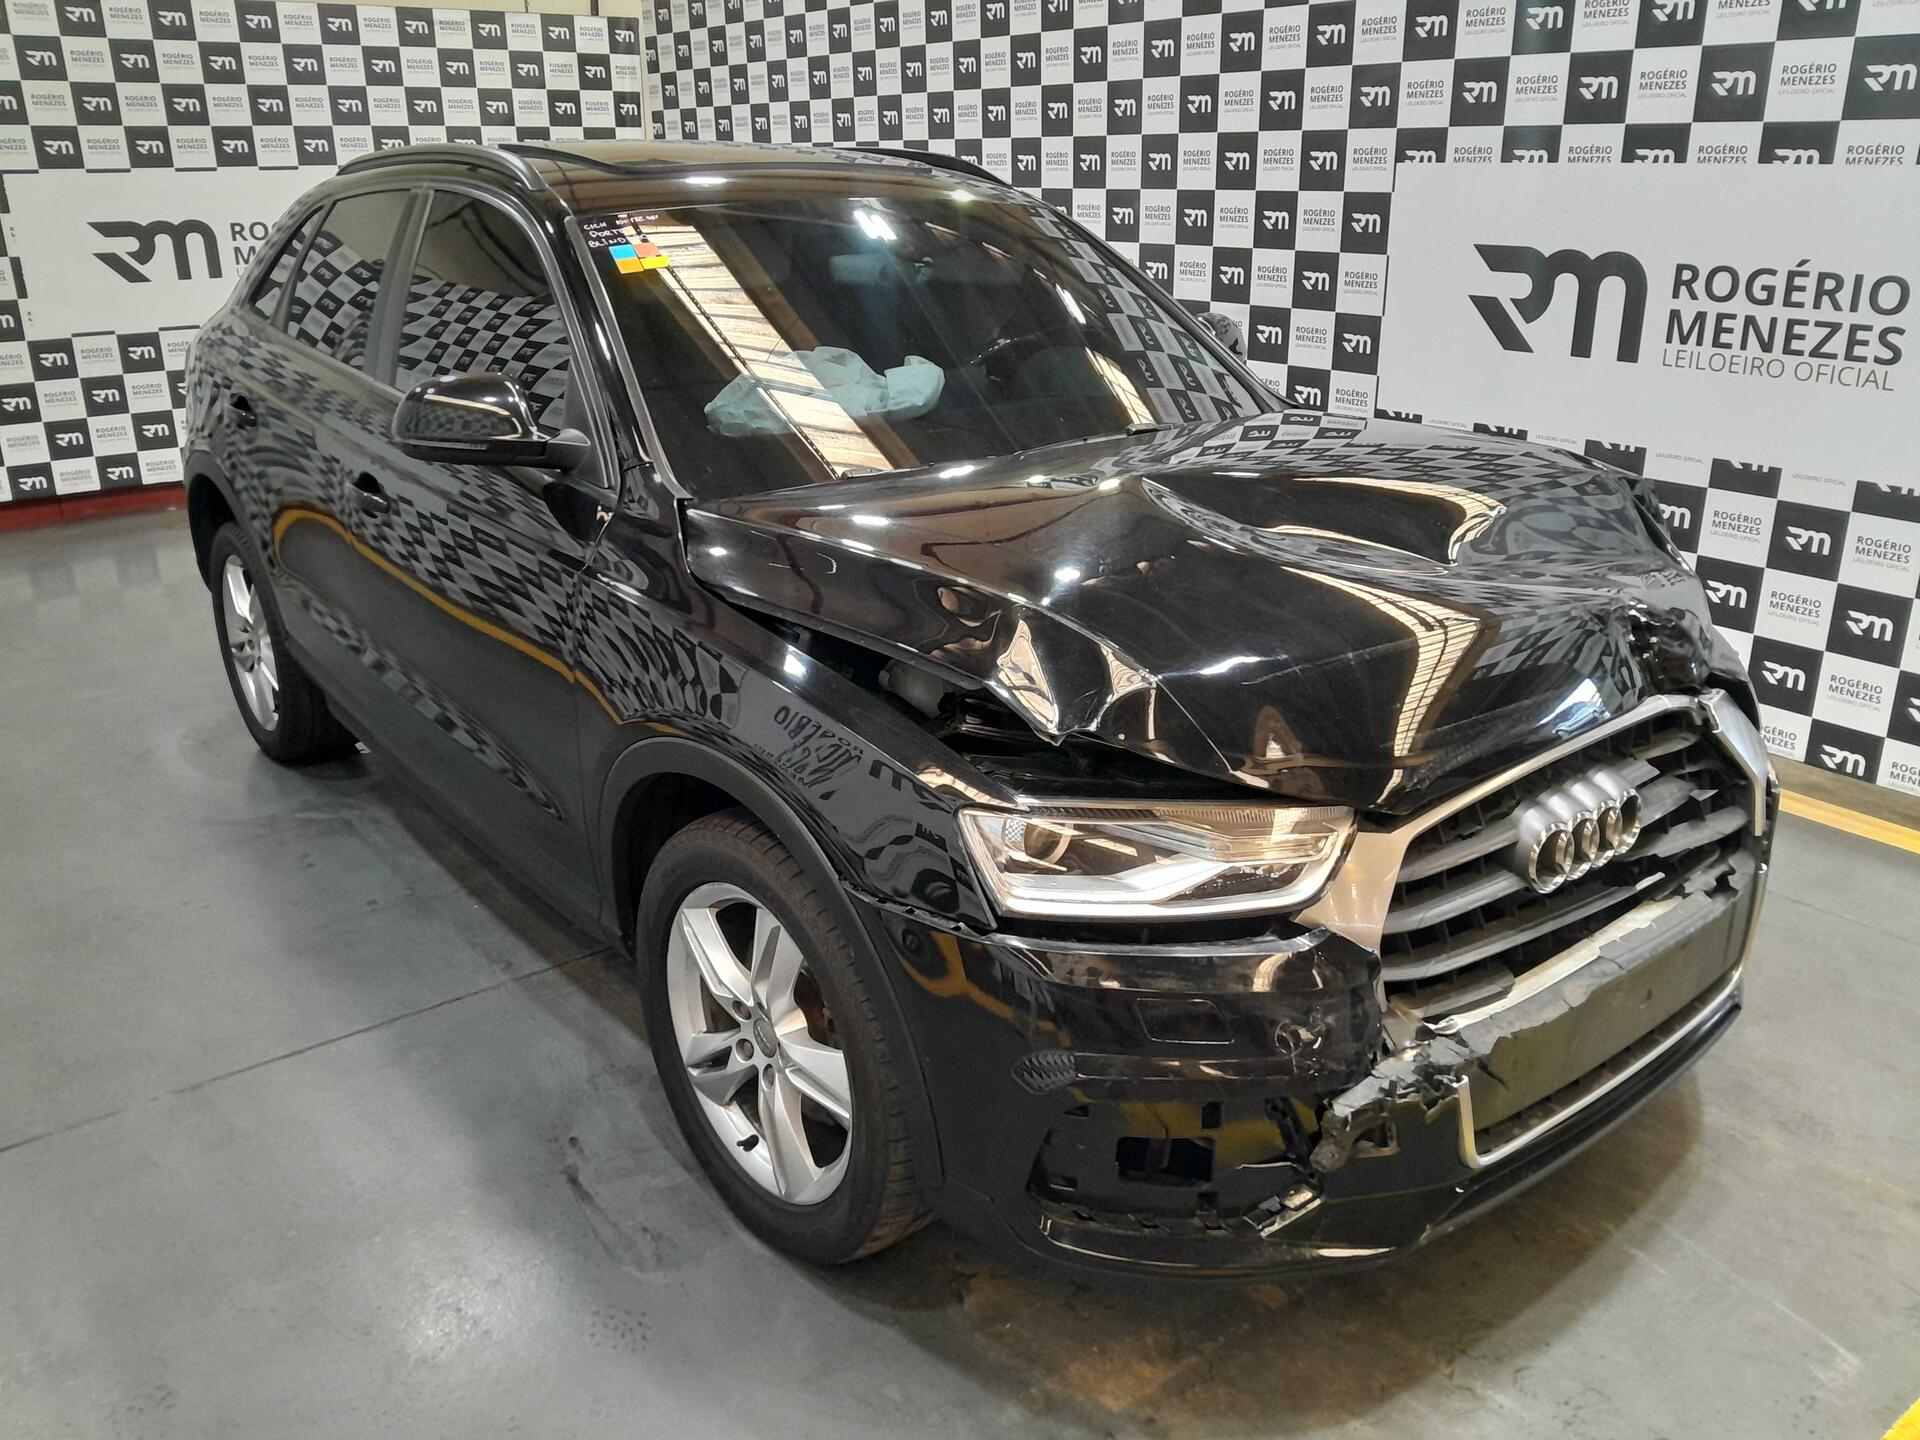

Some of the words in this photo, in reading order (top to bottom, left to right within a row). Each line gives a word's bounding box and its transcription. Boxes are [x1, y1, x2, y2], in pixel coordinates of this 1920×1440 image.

[1466, 5, 1506, 18] ROGÉRIO
[1583, 5, 1629, 18] MENEZES
[1362, 15, 1397, 27] ROGÉRIO
[1465, 16, 1505, 27] MENEZES
[1269, 23, 1300, 34] ROGÉRIO
[1361, 25, 1396, 35] MENEZES
[1187, 31, 1215, 42] ROGÉRIO
[1269, 33, 1300, 43] MENEZES
[1113, 38, 1138, 48] ROGÉRIO
[1187, 40, 1214, 49] MENEZES
[1046, 44, 1068, 54] ROGÉRIO
[1113, 46, 1138, 55] MENEZES
[985, 50, 1006, 59] ROGÉRIO
[1046, 53, 1068, 61] MENEZES
[985, 58, 1006, 66] MENEZES
[1782, 60, 1839, 74] ROGÉRIO
[1640, 67, 1688, 80] ROGÉRIO
[1516, 73, 1558, 85] ROGÉRIO
[1780, 73, 1837, 85] MENEZES
[1310, 84, 1343, 94] ROGÉRIO
[1407, 79, 1444, 90] ROGÉRIO
[1515, 84, 1557, 95] MENEZES
[1638, 79, 1687, 90] MENEZES
[1148, 92, 1173, 102] ROGÉRIO
[1225, 88, 1253, 98] ROGÉRIO
[1310, 93, 1342, 102] MENEZES
[1406, 89, 1443, 99] MENEZES
[1015, 100, 1036, 108] ROGÉRIO
[1078, 96, 1101, 105] ROGÉRIO
[1147, 101, 1173, 109] MENEZES
[1224, 97, 1253, 106] MENEZES
[1183, 148, 1210, 157] ROGÉRIO
[1263, 147, 1293, 156] ROGÉRIO
[1353, 146, 1387, 156] ROGÉRIO
[1453, 145, 1492, 155] ROGÉRIO
[1567, 144, 1612, 155] ROGÉRIO
[1697, 142, 1748, 154] ROGÉRIO
[1847, 141, 1907, 154] ROGÉRIO
[1046, 150, 1068, 158] ROGÉRIO
[1111, 149, 1135, 158] ROGÉRIO
[1352, 156, 1386, 164] MENEZES
[1077, 202, 1100, 210] ROGÉRIO
[1145, 203, 1170, 212] ROGÉRIO
[1220, 205, 1248, 215] ROGÉRIO
[1145, 212, 1170, 220] MENEZES
[1303, 208, 1335, 217] ROGÉRIO
[1219, 214, 1248, 222] MENEZES
[1303, 217, 1334, 225] MENEZES
[1180, 259, 1206, 269] ROGÉRIO
[1257, 264, 1287, 274] ROGÉRIO
[1179, 268, 1205, 276] MENEZES
[1344, 270, 1377, 280] ROGÉRIO
[1257, 273, 1286, 282] MENEZES
[1344, 279, 1377, 289] MENEZES
[1671, 259, 1911, 316] ROGÉRIO
[1296, 325, 1327, 336] ROGÉRIO
[1296, 333, 1326, 343] MENEZES
[1665, 308, 1906, 366] MENEZES
[1662, 348, 1785, 379] LEILOEIRO
[1794, 361, 1895, 392] OFICIAL
[1336, 387, 1368, 399] ROGÉRIO
[1336, 395, 1368, 407] MENEZES
[1712, 509, 1761, 526] ROGÉRIO
[1711, 518, 1760, 535] MENEZES
[1856, 534, 1913, 553] ROGÉRIO
[1854, 544, 1911, 563] MENEZES
[1770, 589, 1821, 609] ROGÉRIO
[1768, 599, 1820, 618] MENEZES
[1829, 673, 1884, 695] ROGÉRIO
[1828, 682, 1882, 704] MENEZES
[1763, 725, 1797, 741] GÉRIO
[1762, 736, 1796, 750] NEZES
